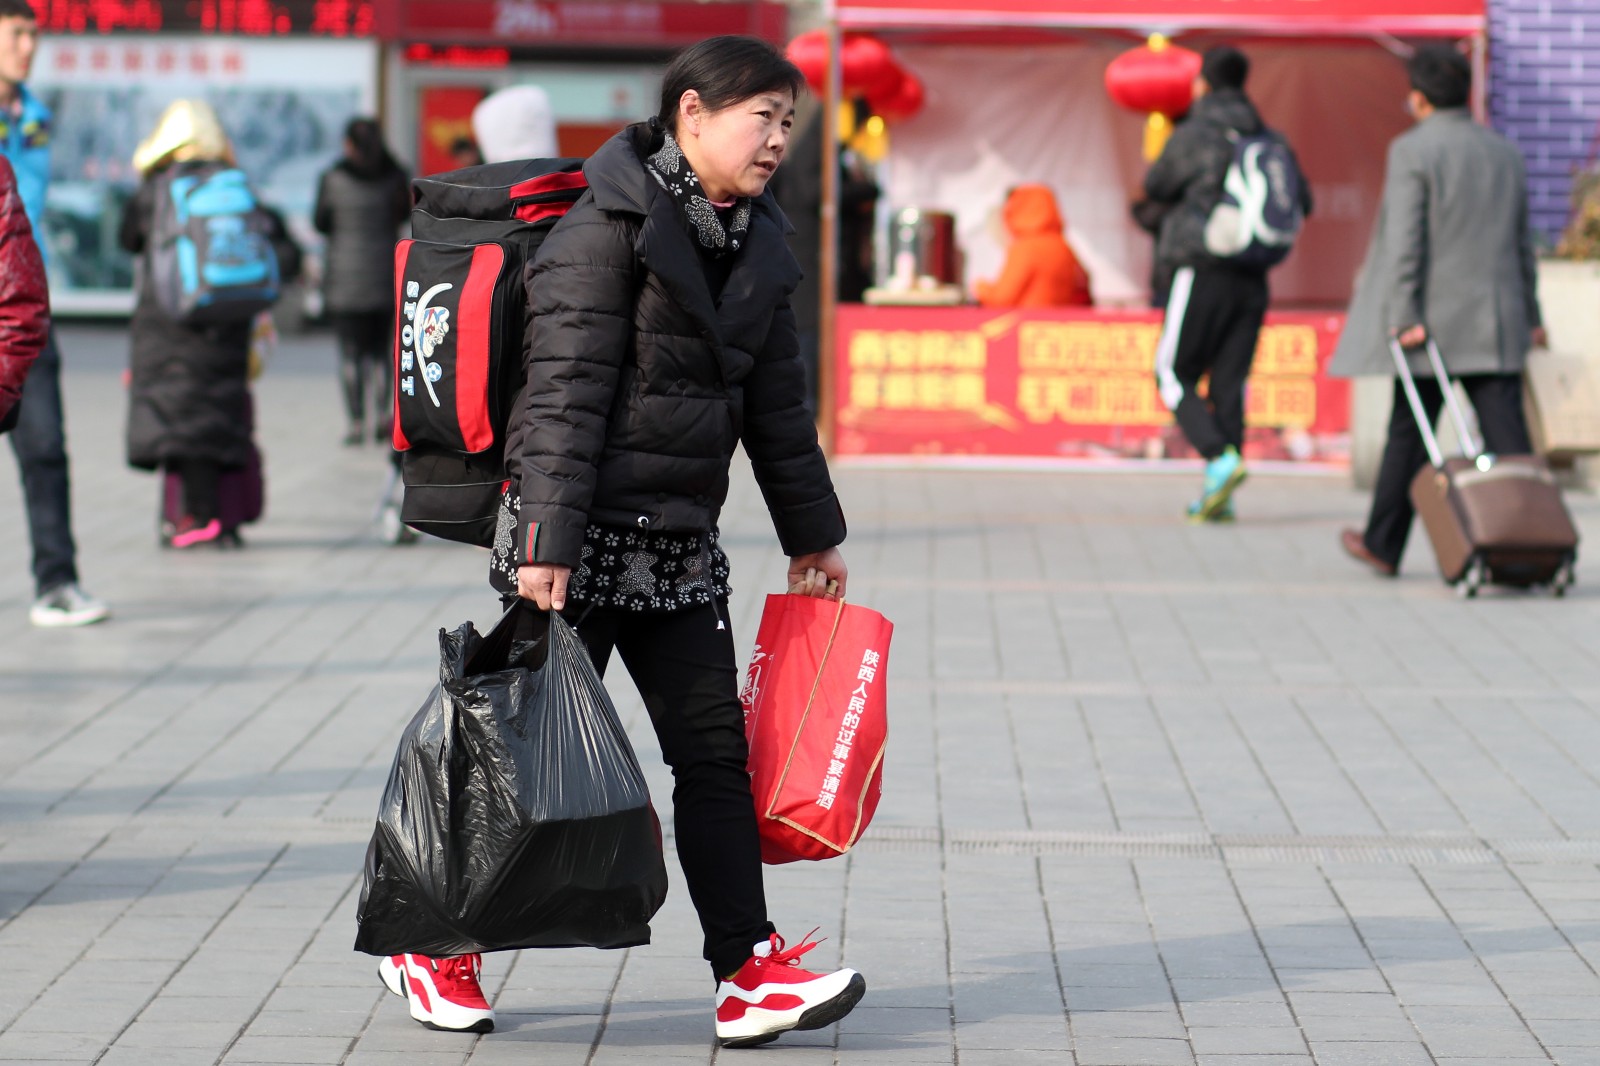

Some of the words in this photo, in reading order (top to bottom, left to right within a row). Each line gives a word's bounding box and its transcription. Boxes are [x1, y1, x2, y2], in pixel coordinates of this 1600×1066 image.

[401, 280, 420, 396] SPORT
[815, 648, 881, 811] 陕西人民的过事宴请酒
